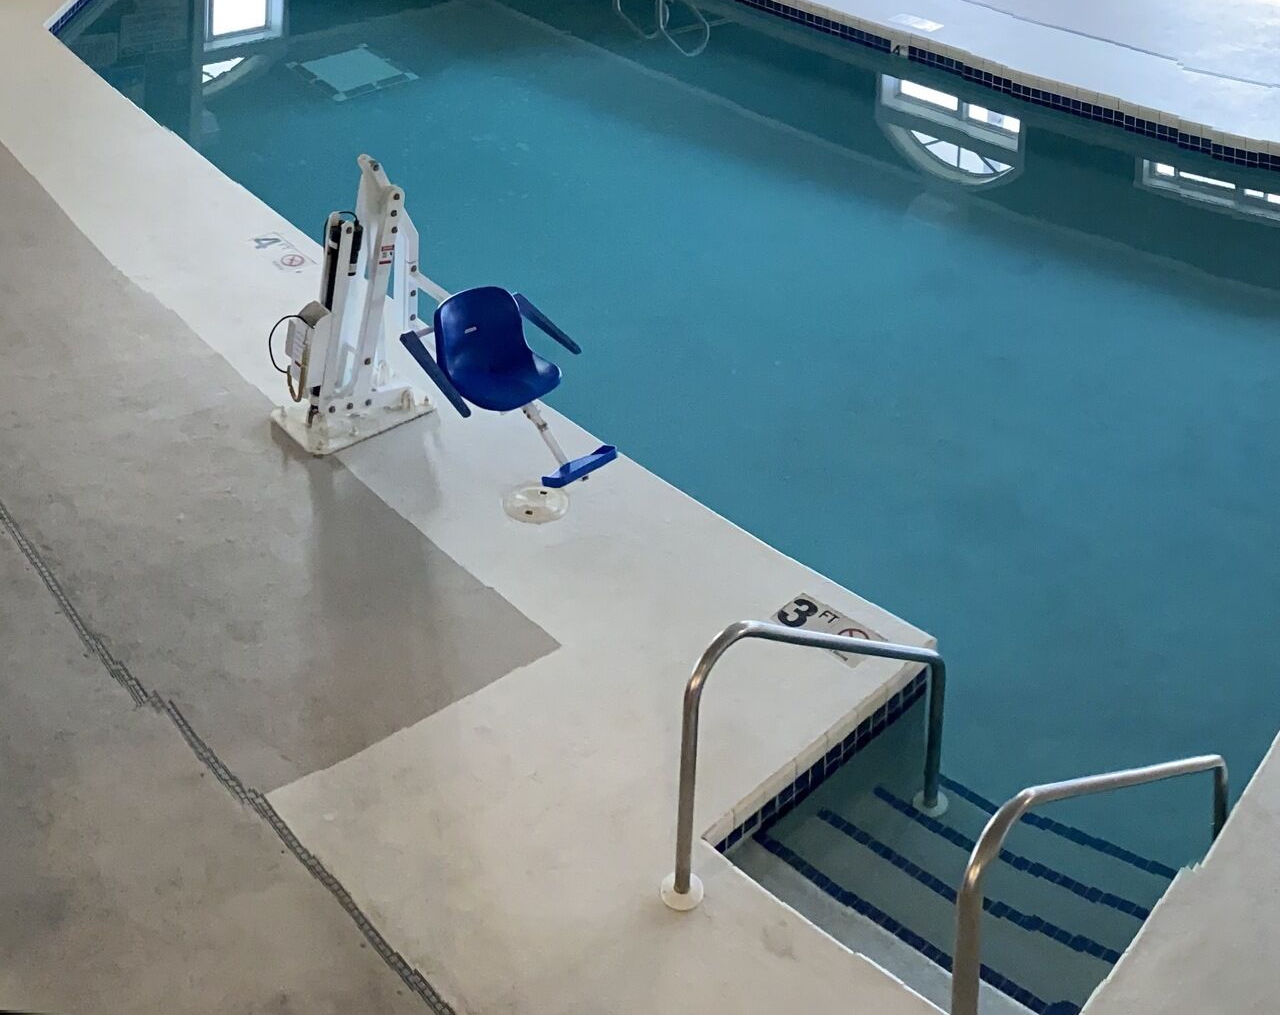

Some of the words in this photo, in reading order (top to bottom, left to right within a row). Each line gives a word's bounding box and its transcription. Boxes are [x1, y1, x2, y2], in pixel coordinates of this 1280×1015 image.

[892, 44, 900, 56] 4
[254, 238, 282, 249] 4
[777, 598, 819, 628] 3
[818, 610, 841, 624] FT
